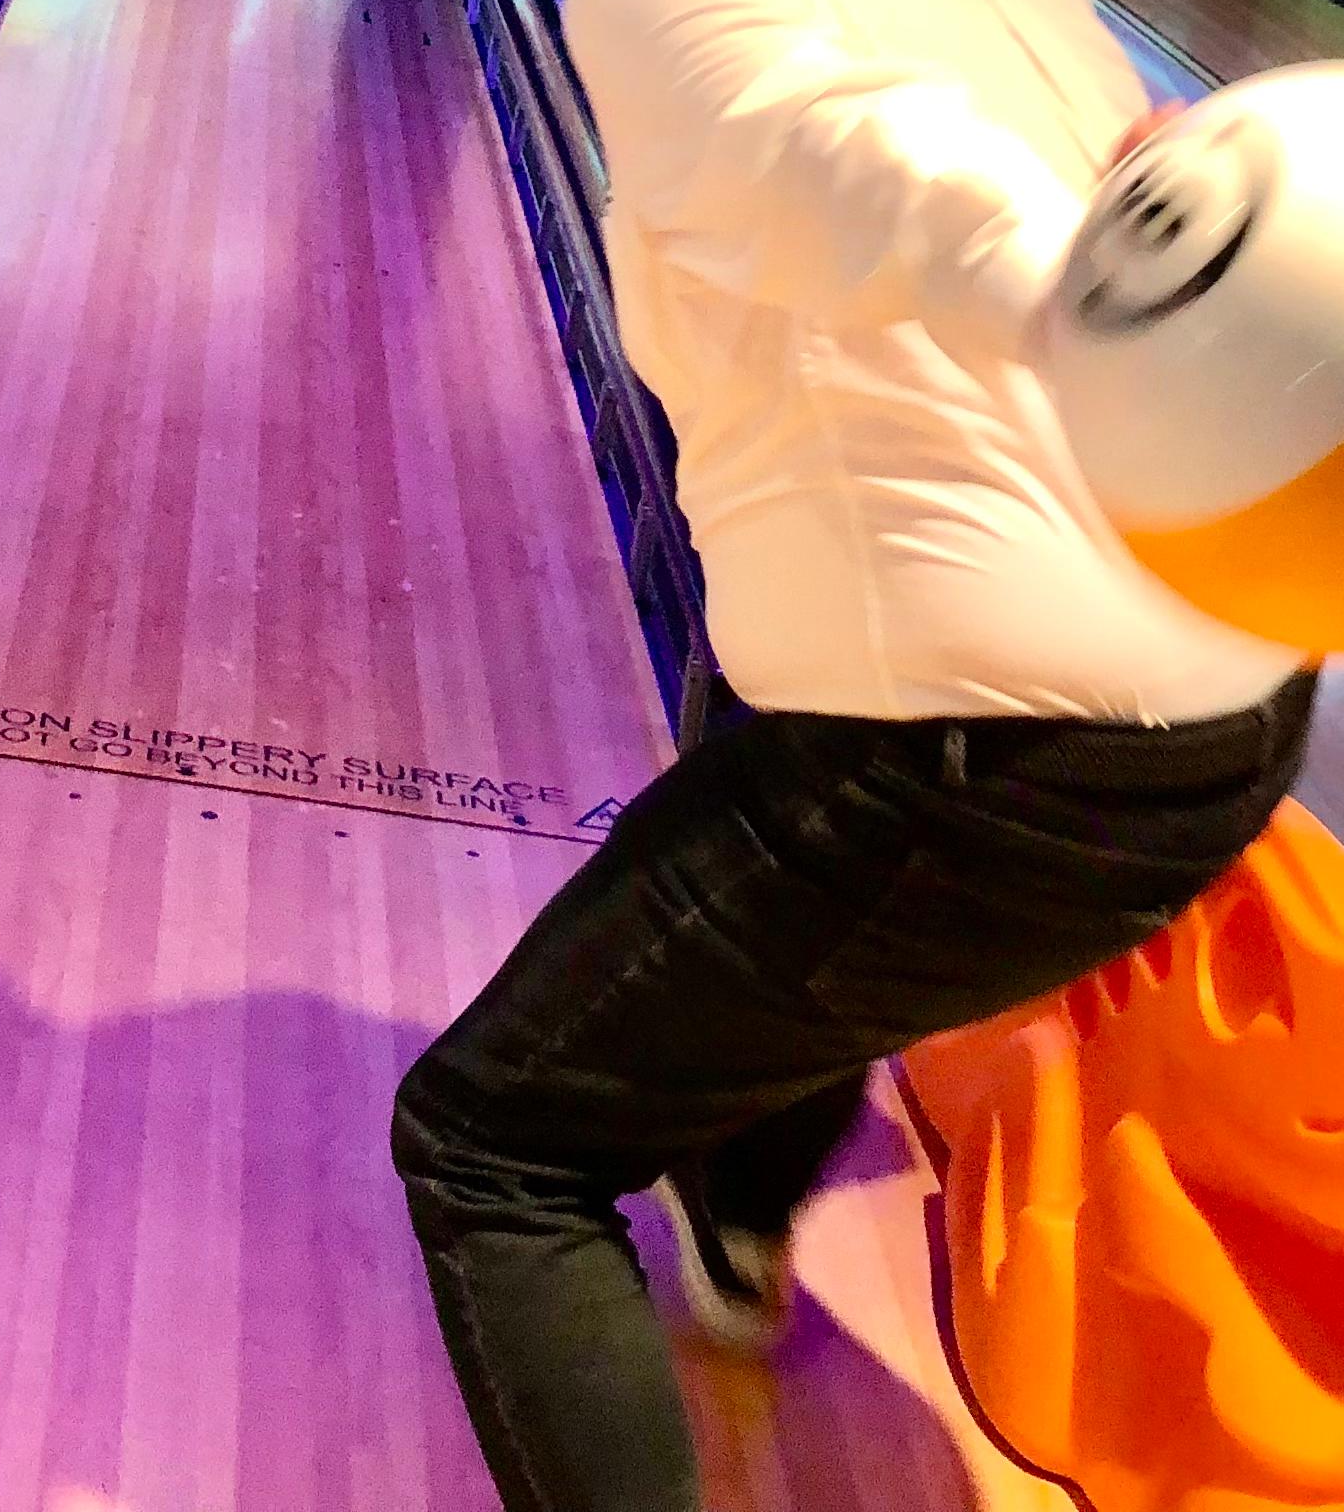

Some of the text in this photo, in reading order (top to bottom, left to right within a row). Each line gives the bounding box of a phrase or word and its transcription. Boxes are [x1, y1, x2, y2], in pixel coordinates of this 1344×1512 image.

[69, 737, 133, 757] GO
[146, 745, 319, 786] BEYOND
[331, 773, 424, 801] THIS
[436, 790, 524, 815] LINE
[88, 719, 327, 768] SLIPPERY
[343, 756, 568, 806] SURFACE
